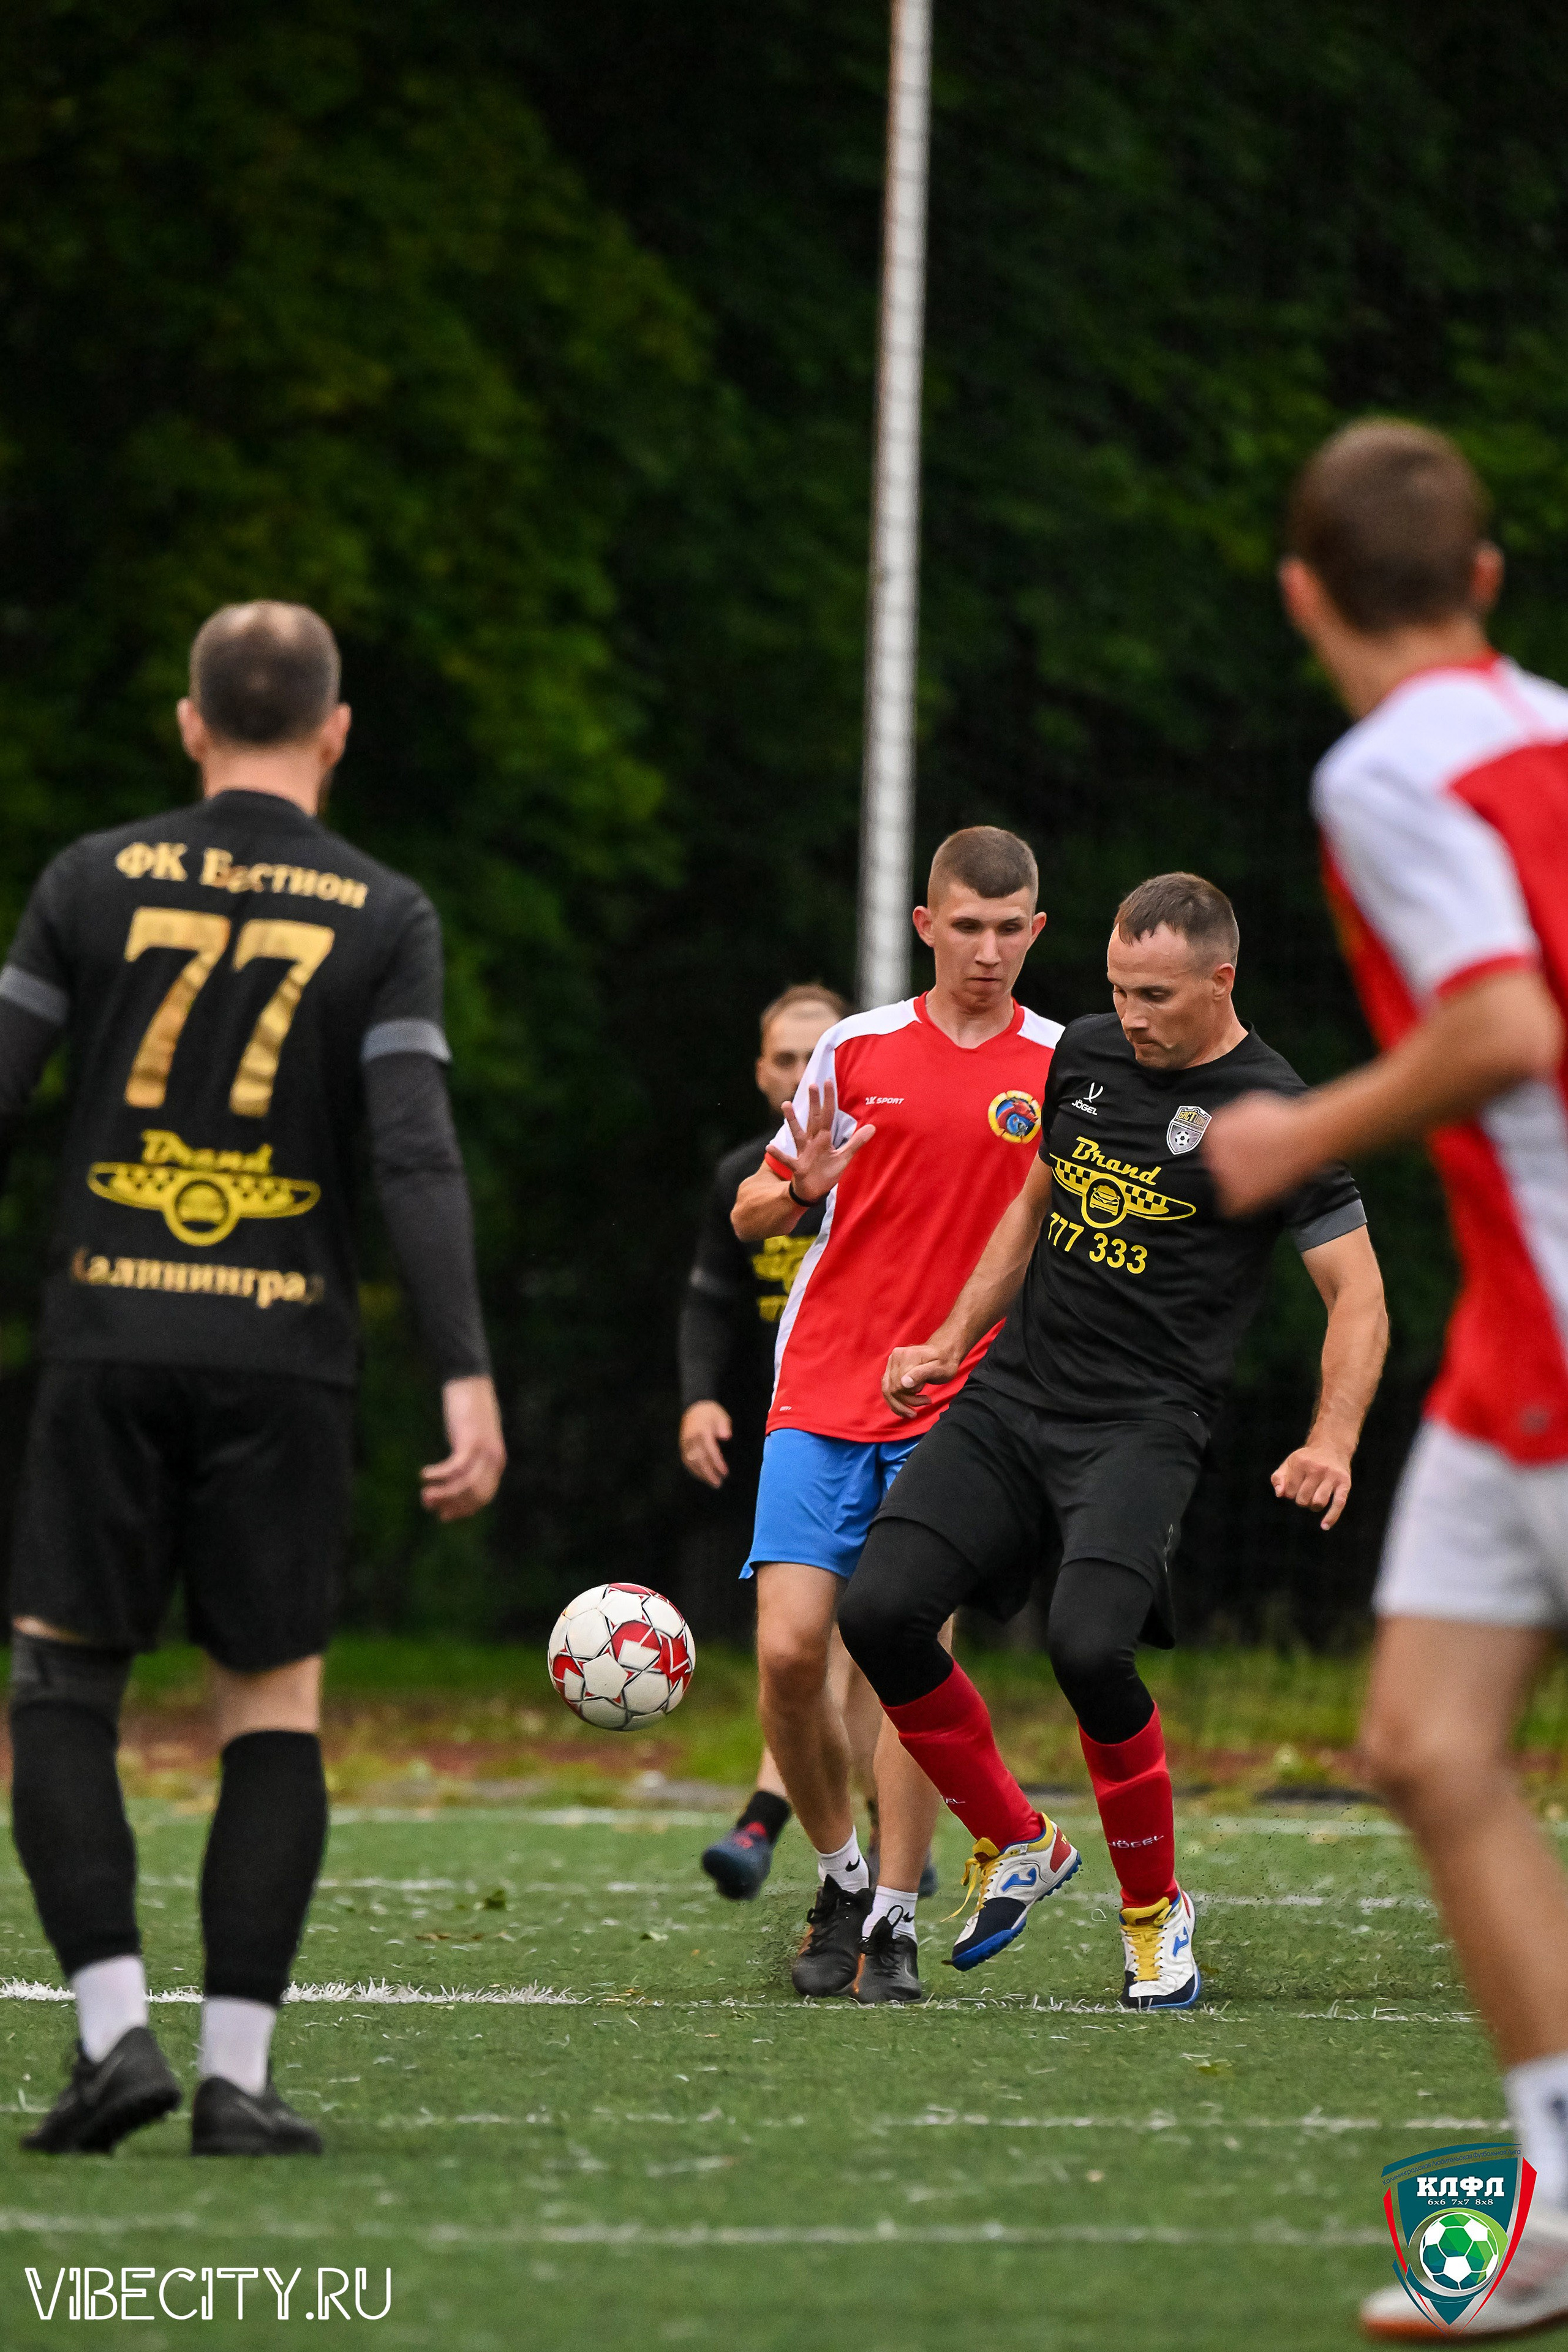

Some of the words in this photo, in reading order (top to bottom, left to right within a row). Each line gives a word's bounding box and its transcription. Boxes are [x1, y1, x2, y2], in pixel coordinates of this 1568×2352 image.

[116, 842, 187, 881] ФК
[124, 906, 335, 1118] 77
[1071, 1099, 1098, 1115] JÖGEL
[1072, 1136, 1161, 1185] Brand
[1048, 1212, 1084, 1252] 777
[1089, 1232, 1148, 1274] 333
